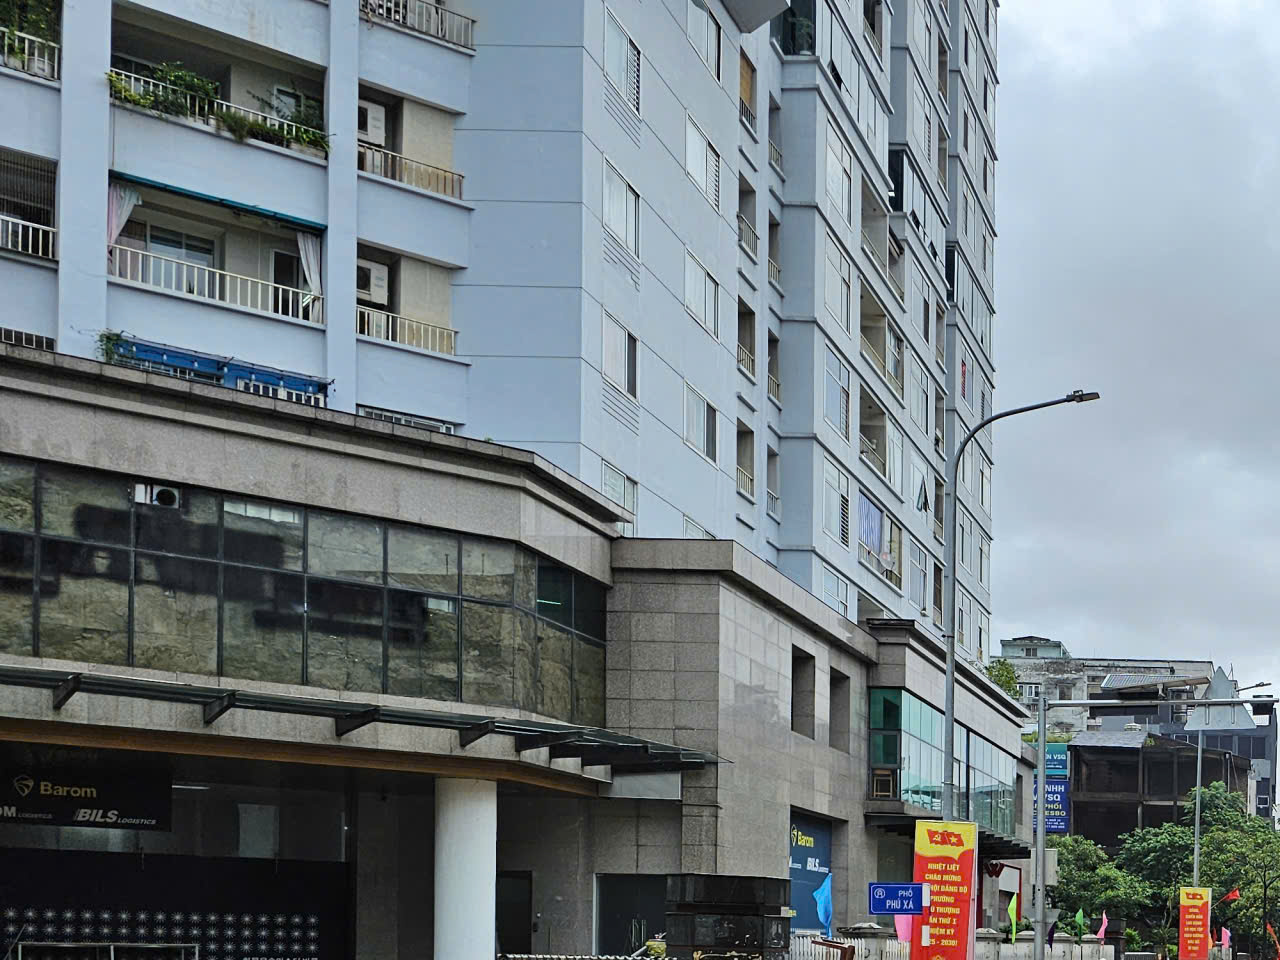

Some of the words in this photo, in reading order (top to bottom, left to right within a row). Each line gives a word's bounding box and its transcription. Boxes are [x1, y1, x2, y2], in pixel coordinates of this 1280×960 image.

[40, 781, 97, 798] Barom
[1045, 785, 1065, 793] NHH
[75, 808, 119, 823] BILS
[797, 831, 814, 848] Barom
[928, 863, 946, 871] NHIỆT
[947, 863, 960, 872] LIỆT
[898, 887, 913, 897] PHỐ
[886, 898, 900, 909] PHÚ
[903, 898, 914, 909] XÁ
[929, 916, 939, 924] ẦN
[929, 927, 945, 935] HIỆM
